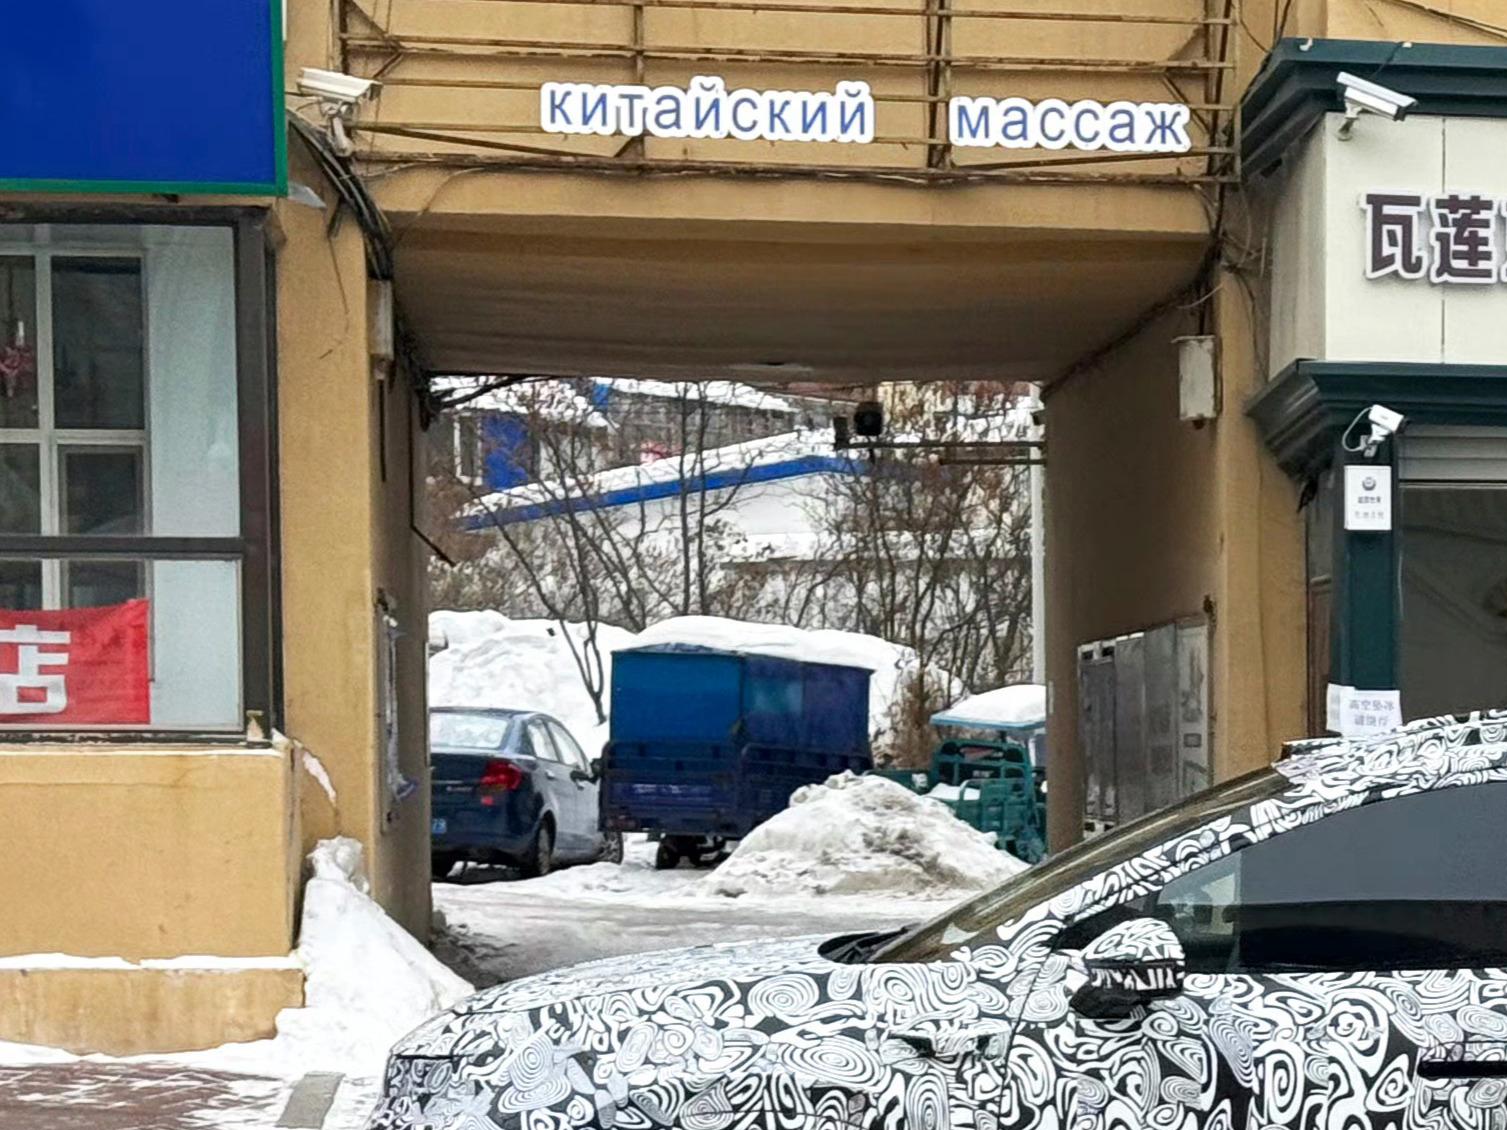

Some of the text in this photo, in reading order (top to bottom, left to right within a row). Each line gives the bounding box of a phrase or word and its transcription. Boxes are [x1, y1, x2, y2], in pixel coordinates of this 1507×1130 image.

[546, 83, 1184, 145] китайский массаж
[0, 624, 71, 714] 店
